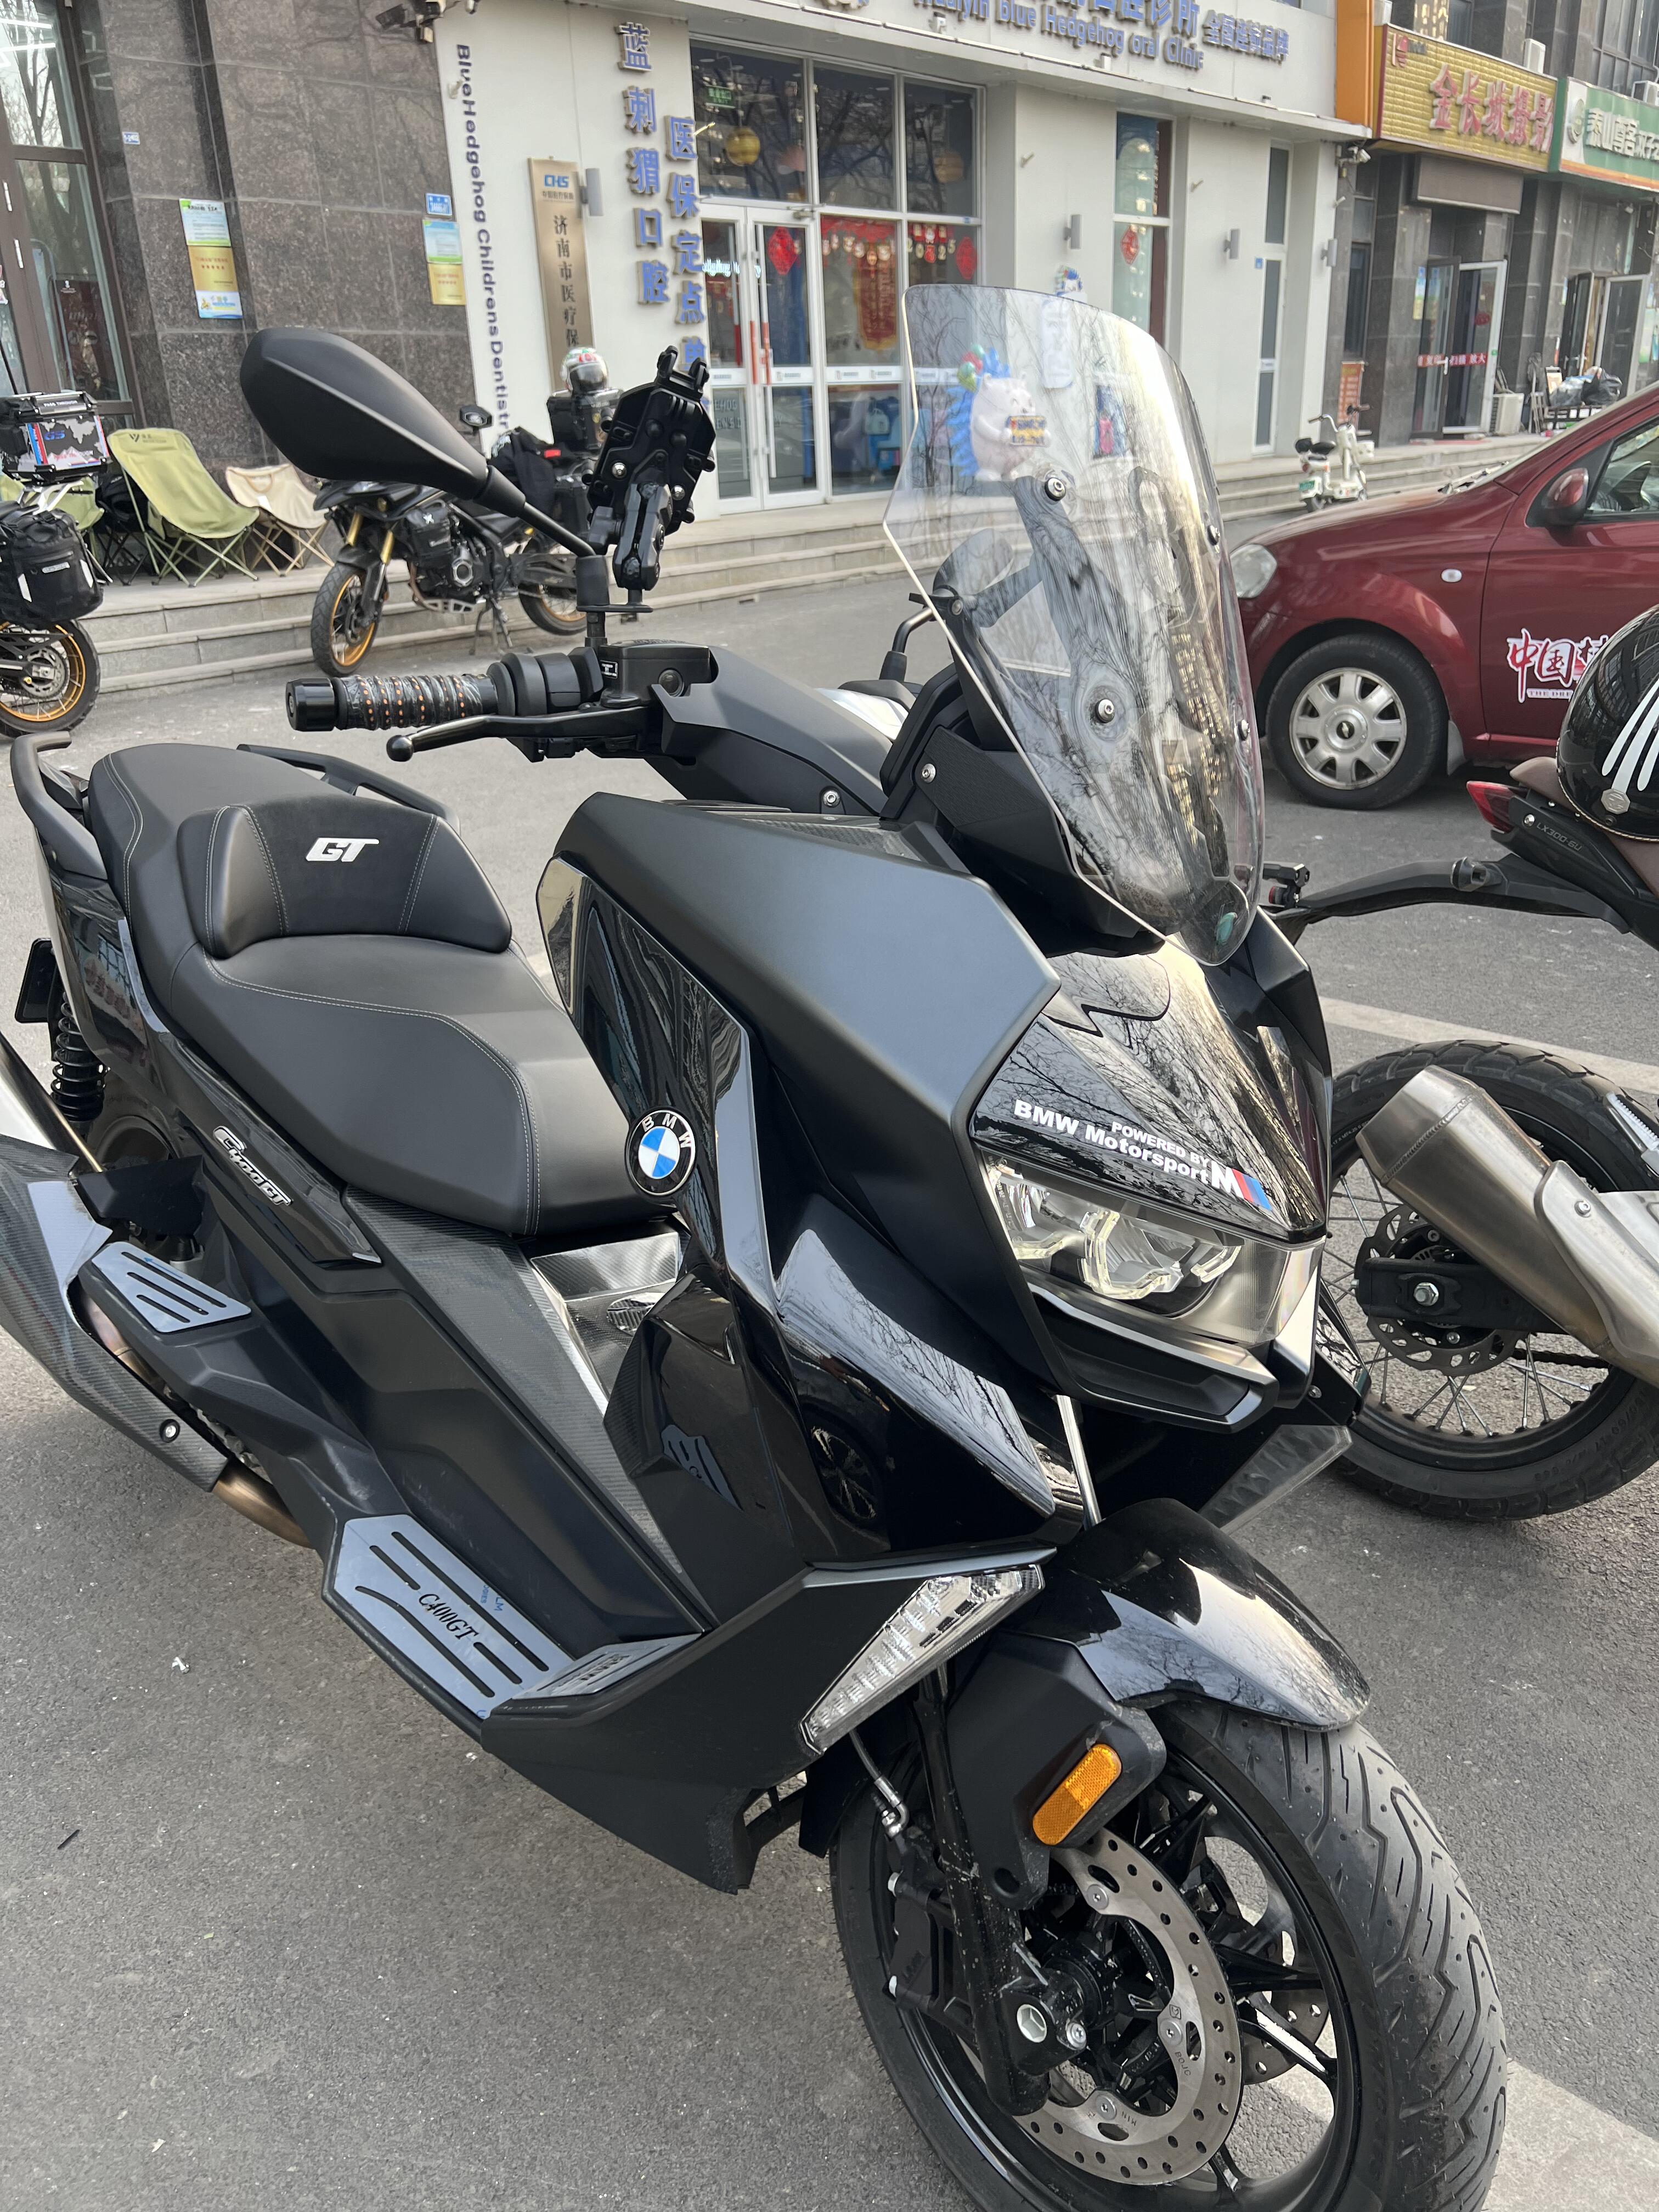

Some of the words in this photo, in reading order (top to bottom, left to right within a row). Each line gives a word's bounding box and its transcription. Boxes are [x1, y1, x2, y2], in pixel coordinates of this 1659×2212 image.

[998, 0, 1036, 27] blue
[1044, 4, 1125, 54] Hedgehog
[1131, 33, 1160, 58] oral
[1166, 37, 1204, 69] Clinic
[1430, 63, 1554, 153] 金长城摄影
[545, 175, 569, 188] CHS
[616, 22, 669, 304] 蓝刺猬口腔
[554, 215, 579, 347] 济南市医疗保
[664, 115, 708, 384] 医保定点单
[477, 229, 499, 336] Childrens
[491, 341, 510, 432] Dentistr
[306, 837, 380, 862] GT
[641, 1113, 692, 1148] BMW
[1014, 1099, 1080, 1136] BMW
[1085, 1124, 1209, 1186] Motorsport
[1111, 1121, 1186, 1158] POWERED
[1190, 1151, 1210, 1169] BY
[419, 1594, 479, 1640] C400GT
